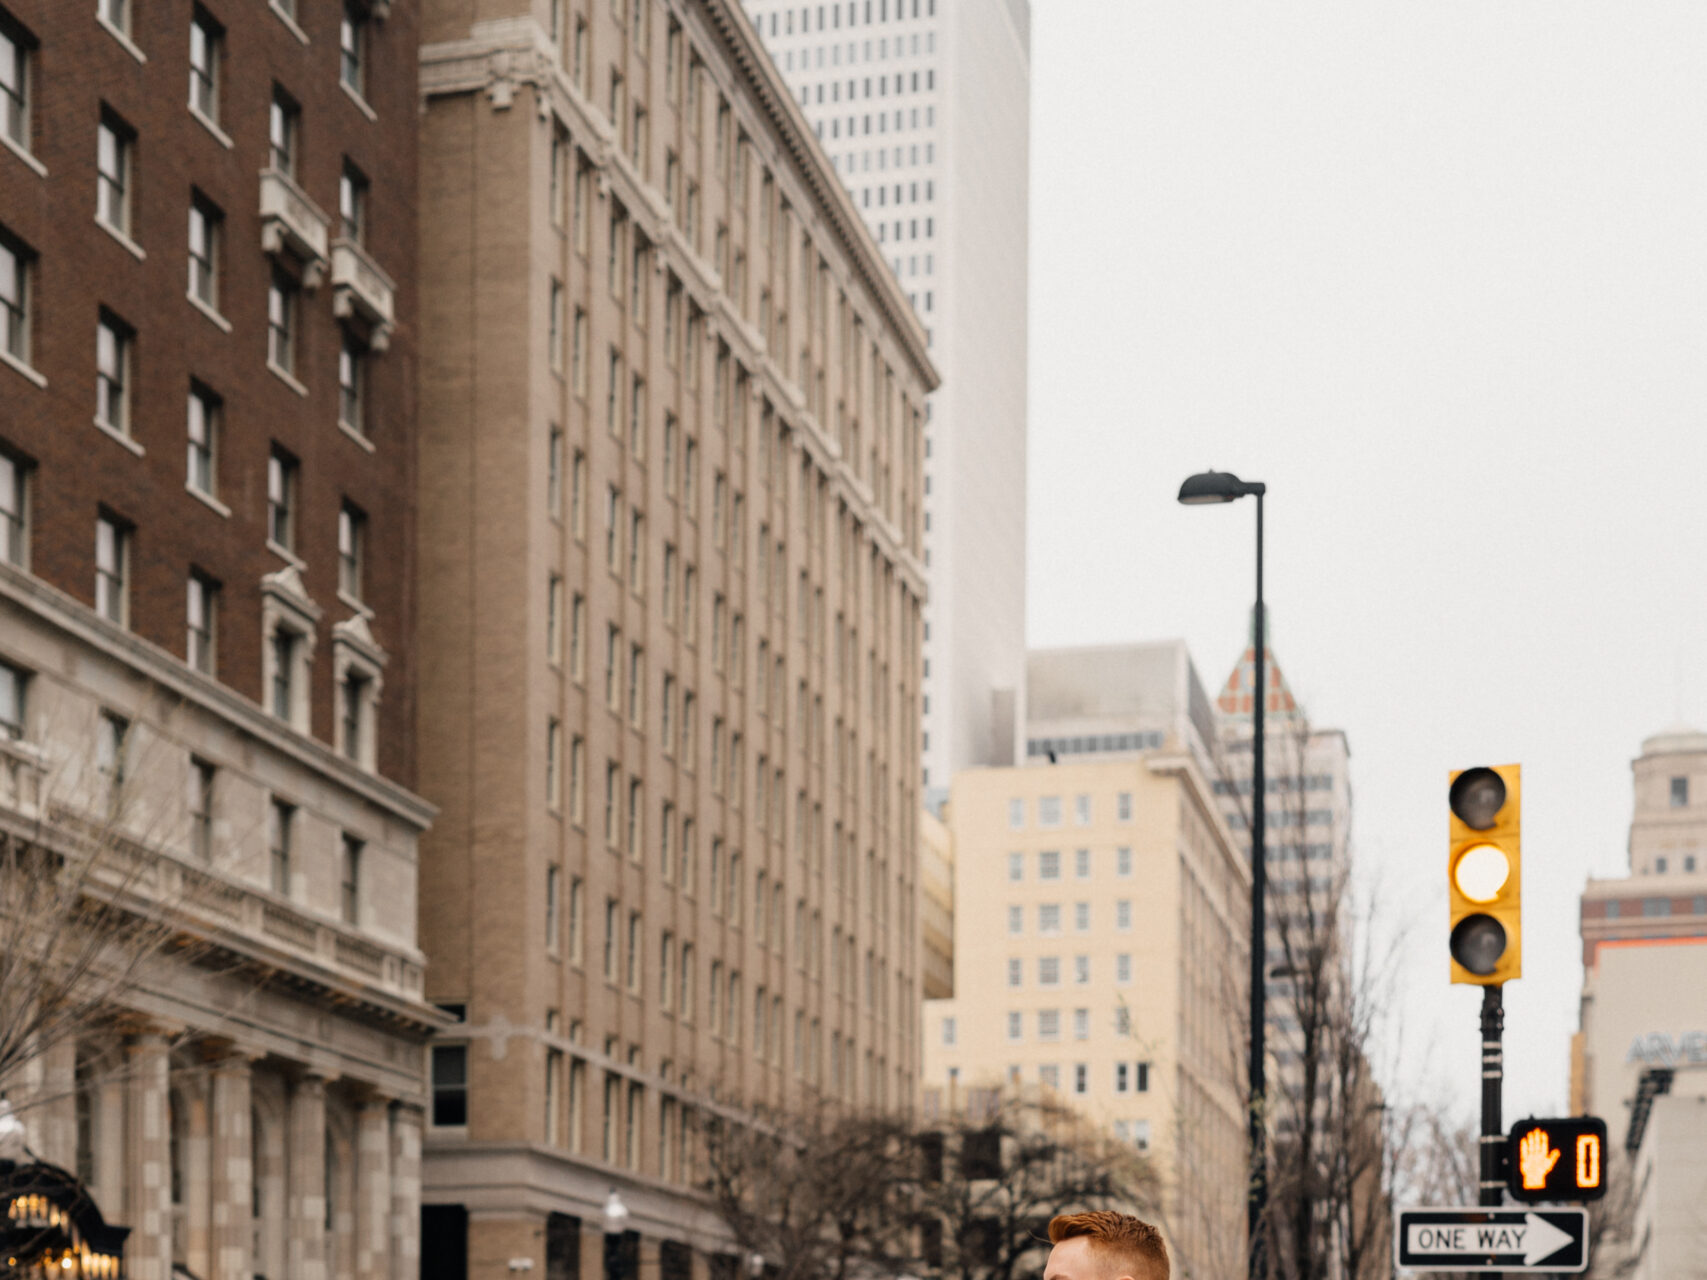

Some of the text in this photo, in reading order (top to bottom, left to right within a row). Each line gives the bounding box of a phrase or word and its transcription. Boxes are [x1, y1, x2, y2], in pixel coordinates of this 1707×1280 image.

[1576, 1133, 1600, 1188] 0
[1418, 1229, 1526, 1249] ONE WAY
